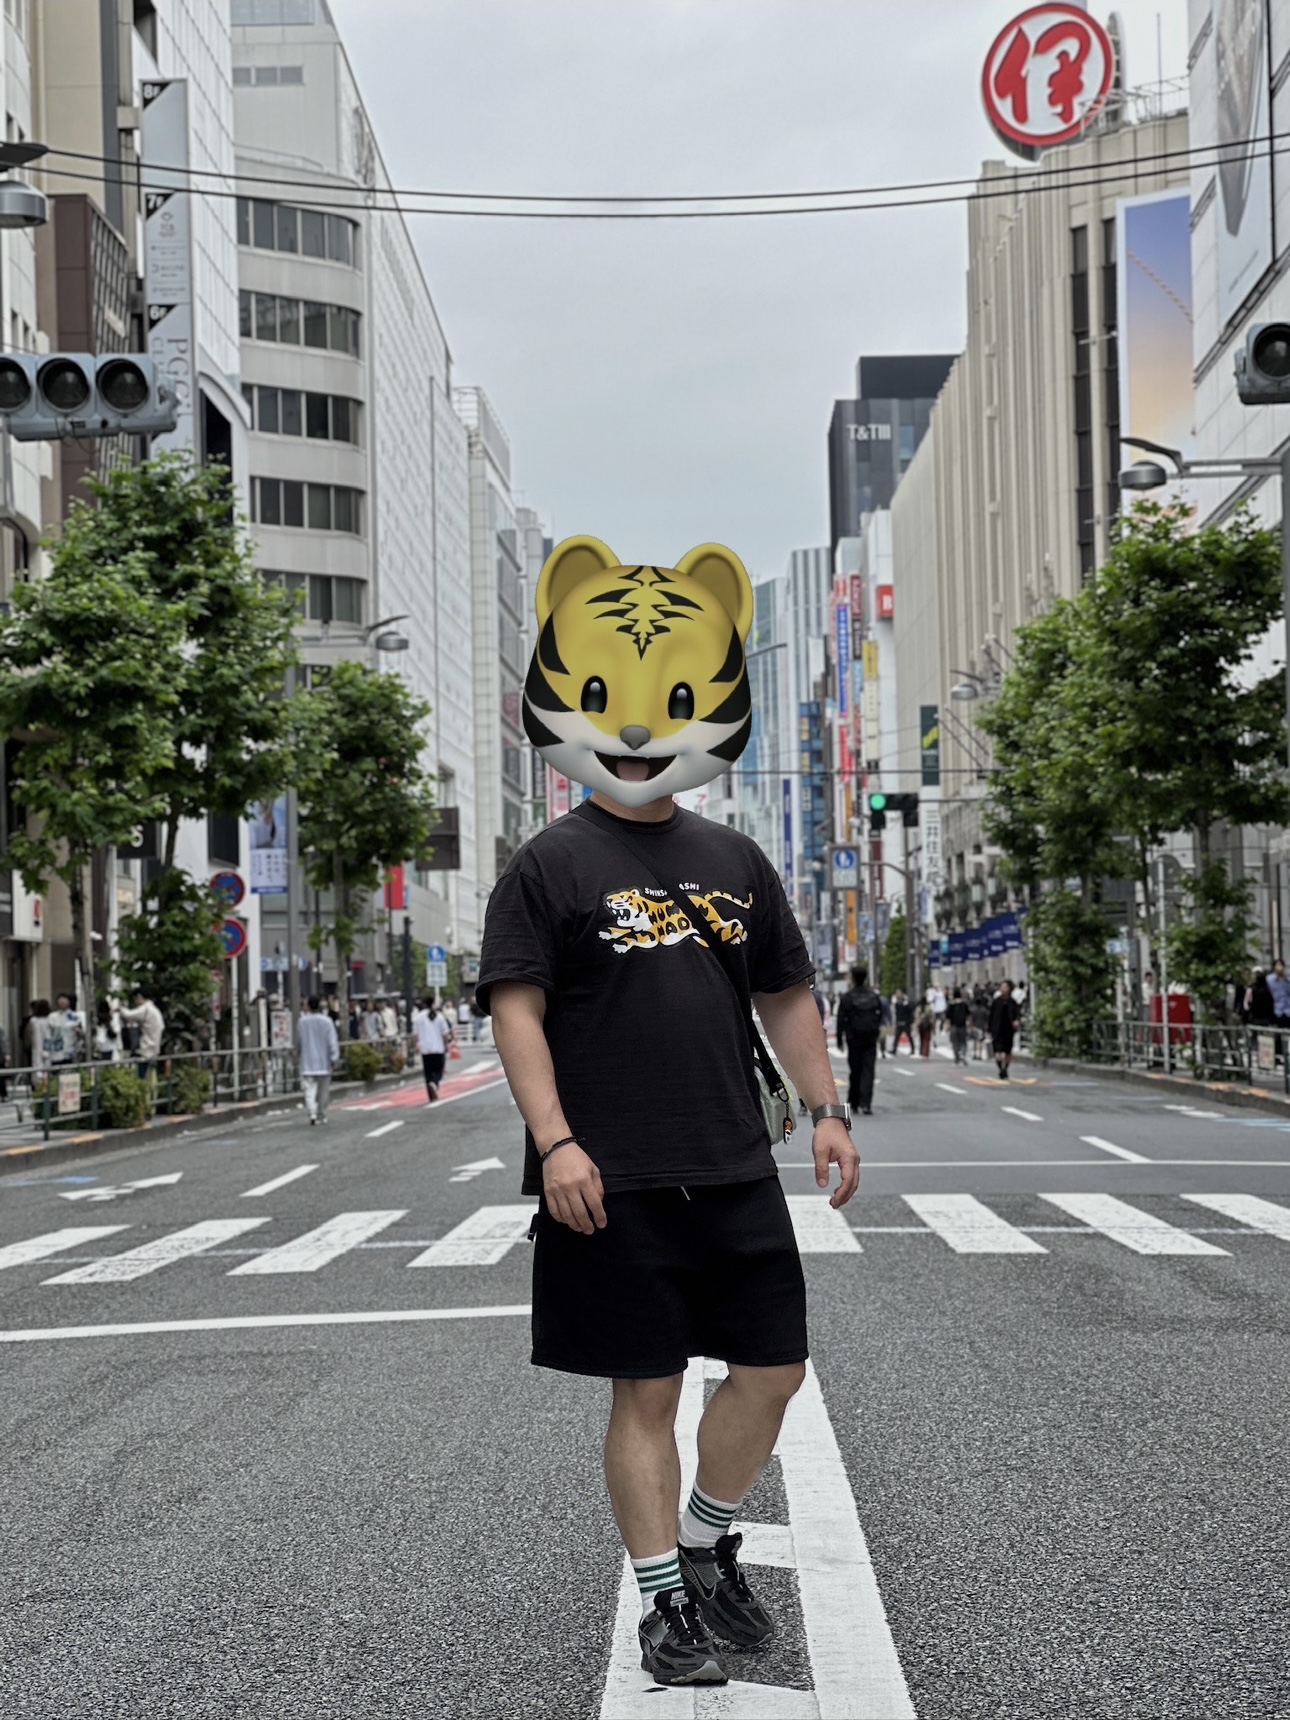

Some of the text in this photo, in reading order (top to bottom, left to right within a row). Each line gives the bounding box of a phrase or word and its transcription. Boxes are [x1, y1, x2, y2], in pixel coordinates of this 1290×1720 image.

[144, 84, 161, 99] 8F
[147, 194, 164, 210] 7F
[150, 305, 168, 321] 6F
[882, 594, 894, 611] B
[671, 1590, 686, 1601] NIKE
